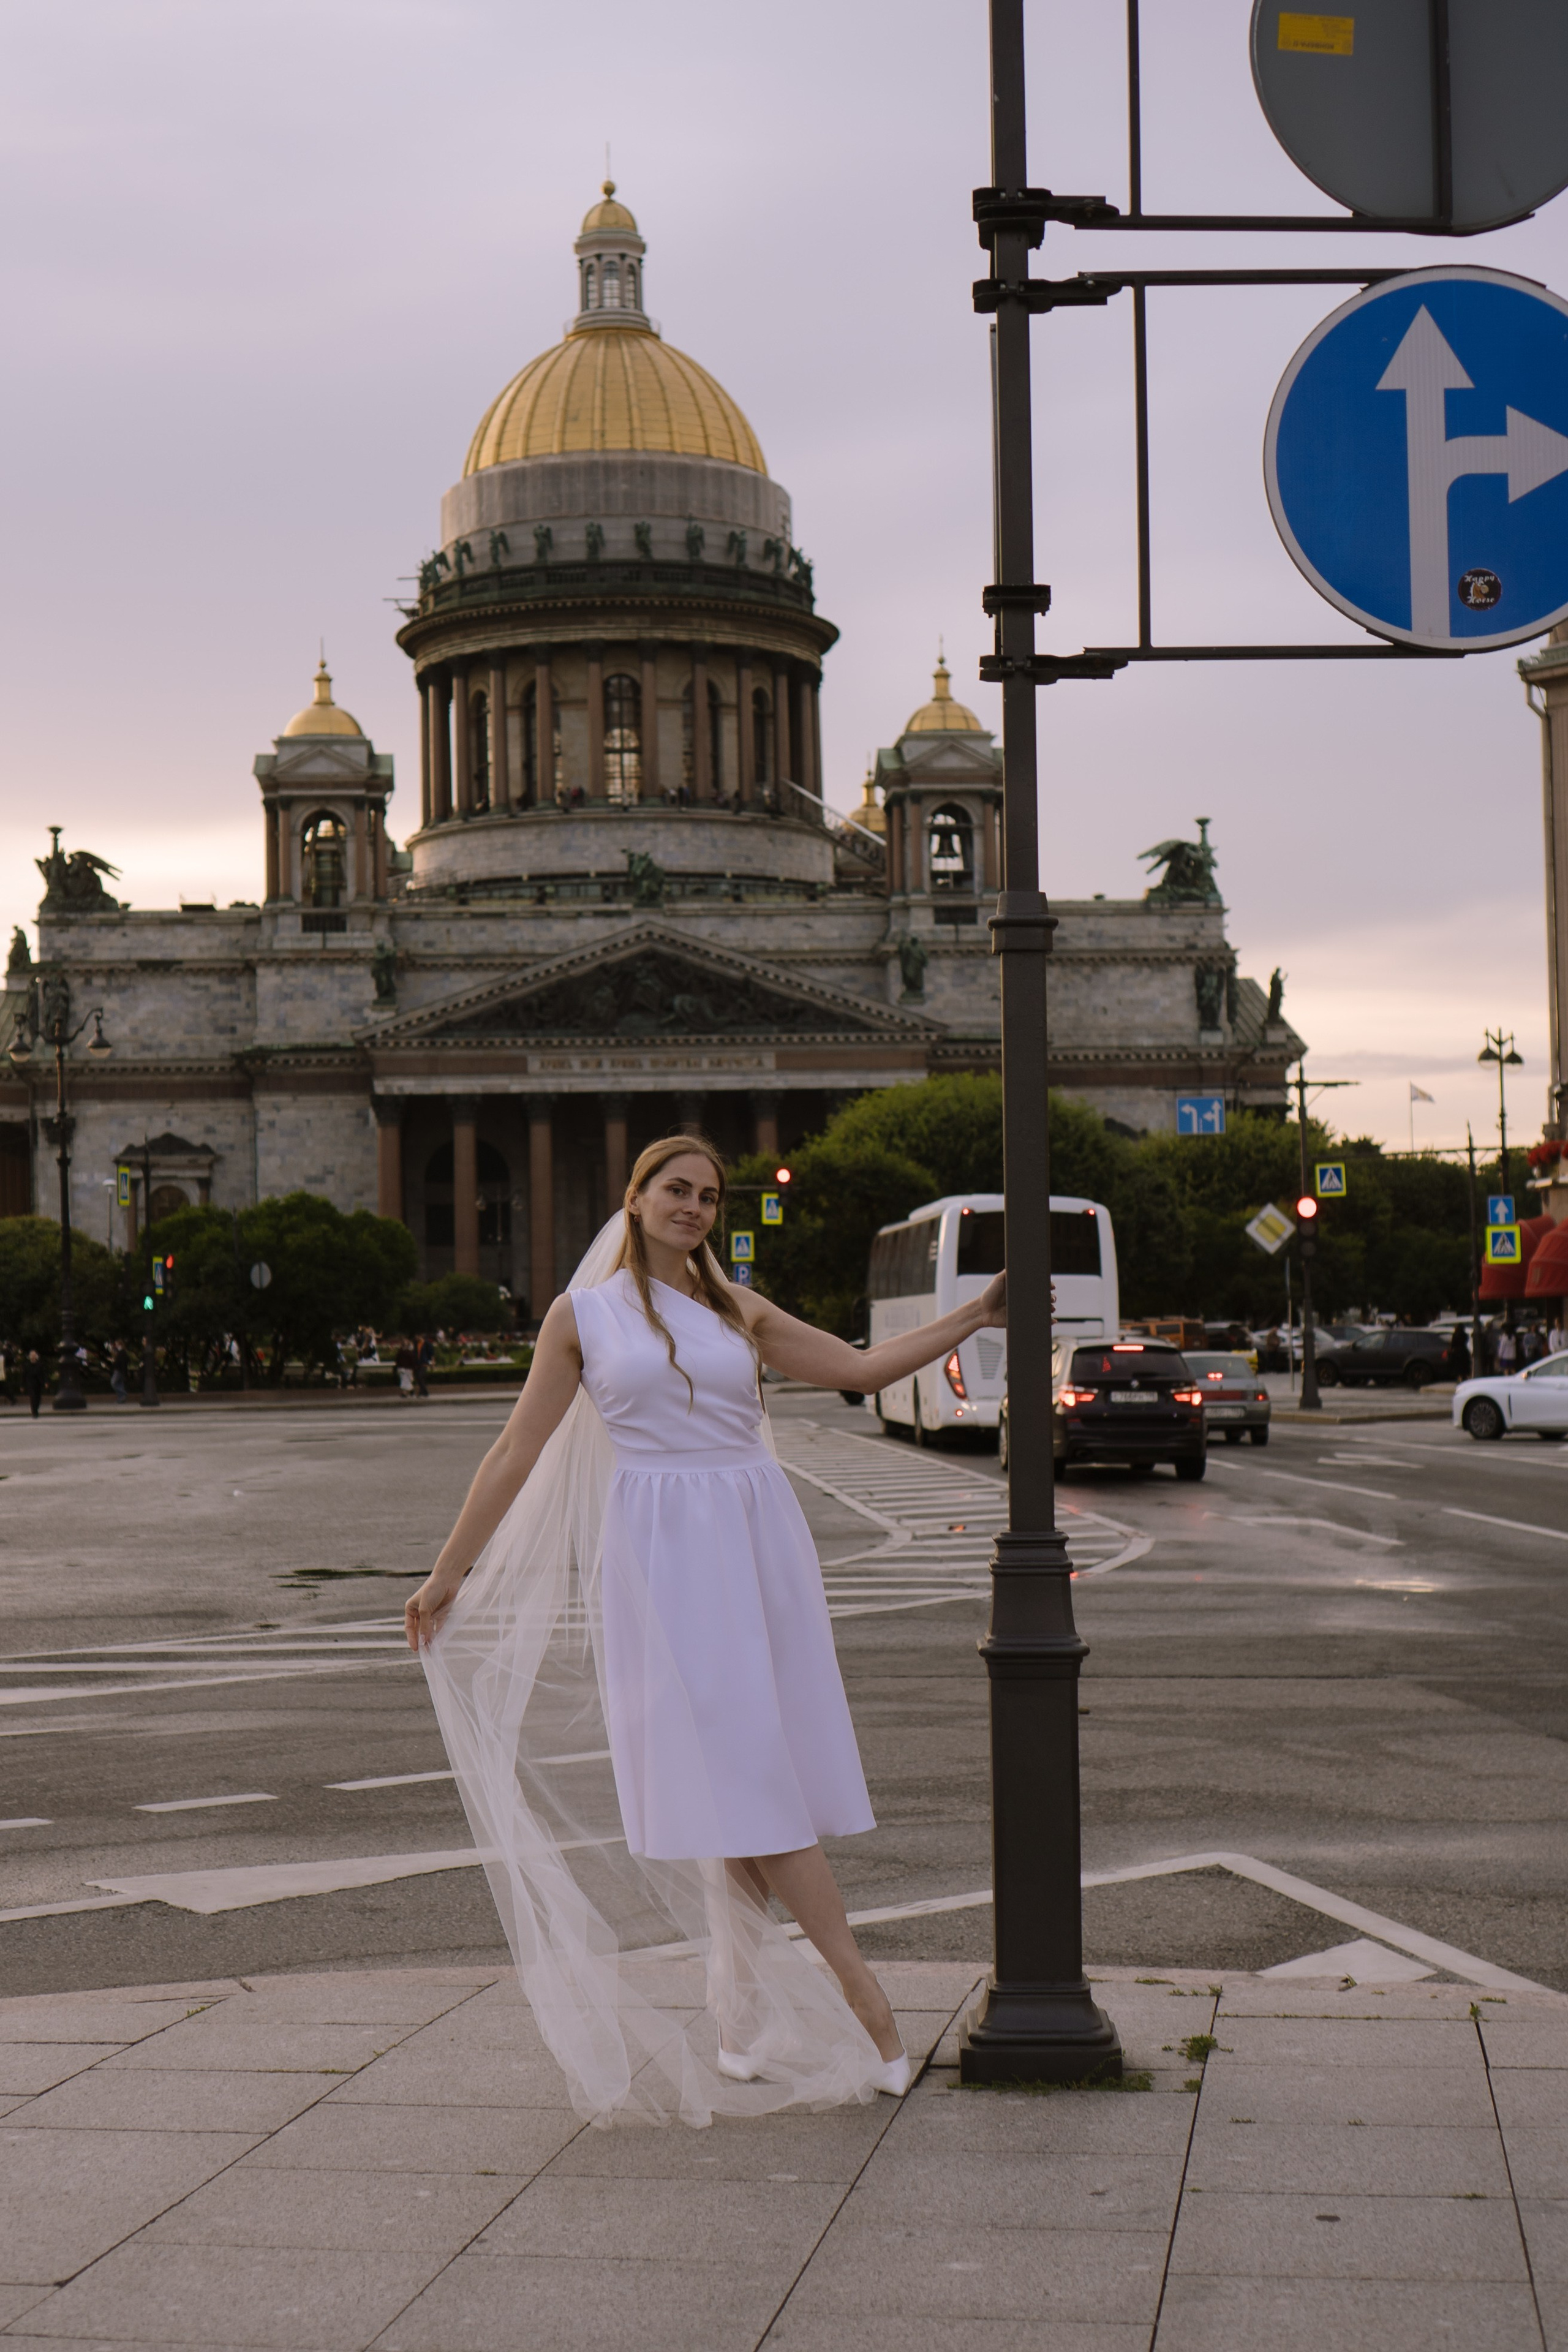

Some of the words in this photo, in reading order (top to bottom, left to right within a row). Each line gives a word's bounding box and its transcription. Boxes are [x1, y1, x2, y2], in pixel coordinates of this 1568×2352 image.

[1464, 575, 1495, 586] Happy
[1466, 595, 1495, 604] Horse
[739, 1266, 748, 1283] P
